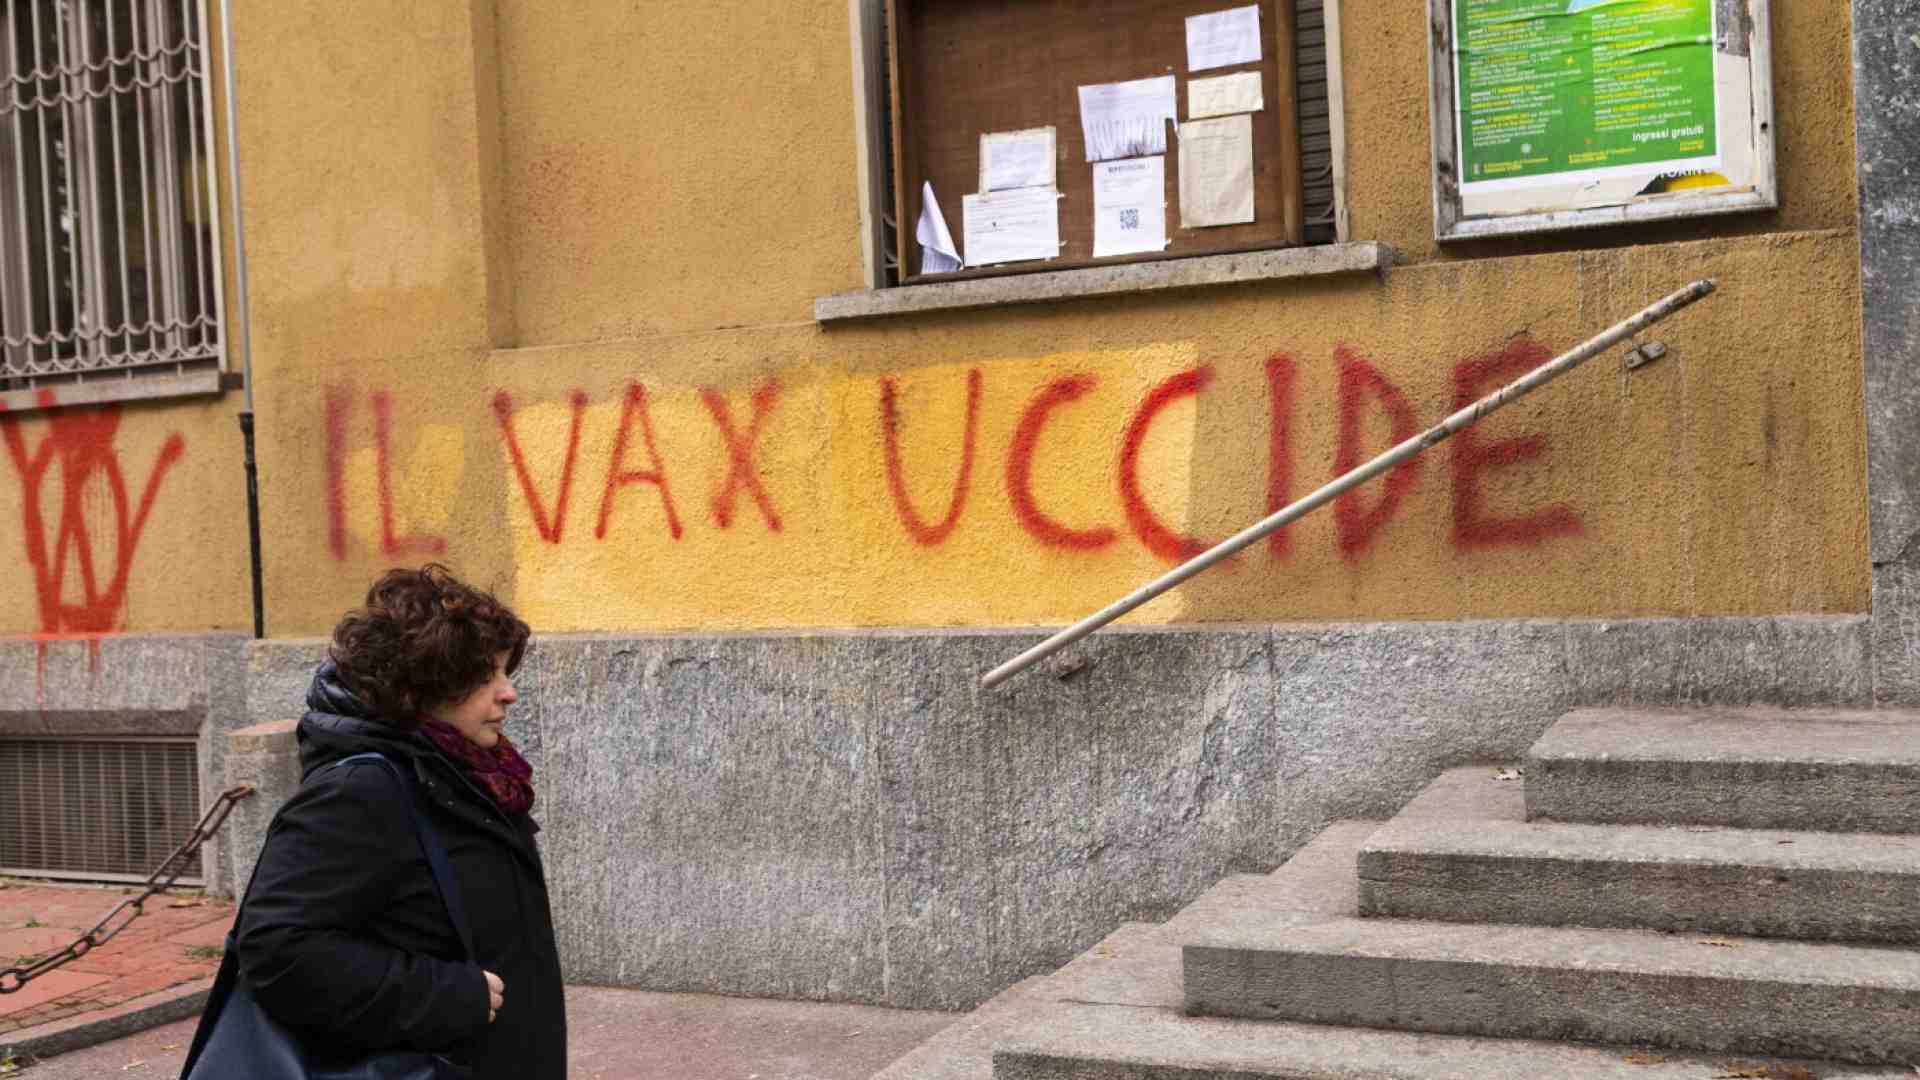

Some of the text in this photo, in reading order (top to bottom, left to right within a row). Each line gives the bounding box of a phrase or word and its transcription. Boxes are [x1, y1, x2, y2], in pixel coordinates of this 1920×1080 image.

[1632, 128, 1669, 142] ingressi
[325, 384, 447, 561] IL
[494, 376, 783, 545] VAX
[879, 338, 1587, 568] UCCIDE
